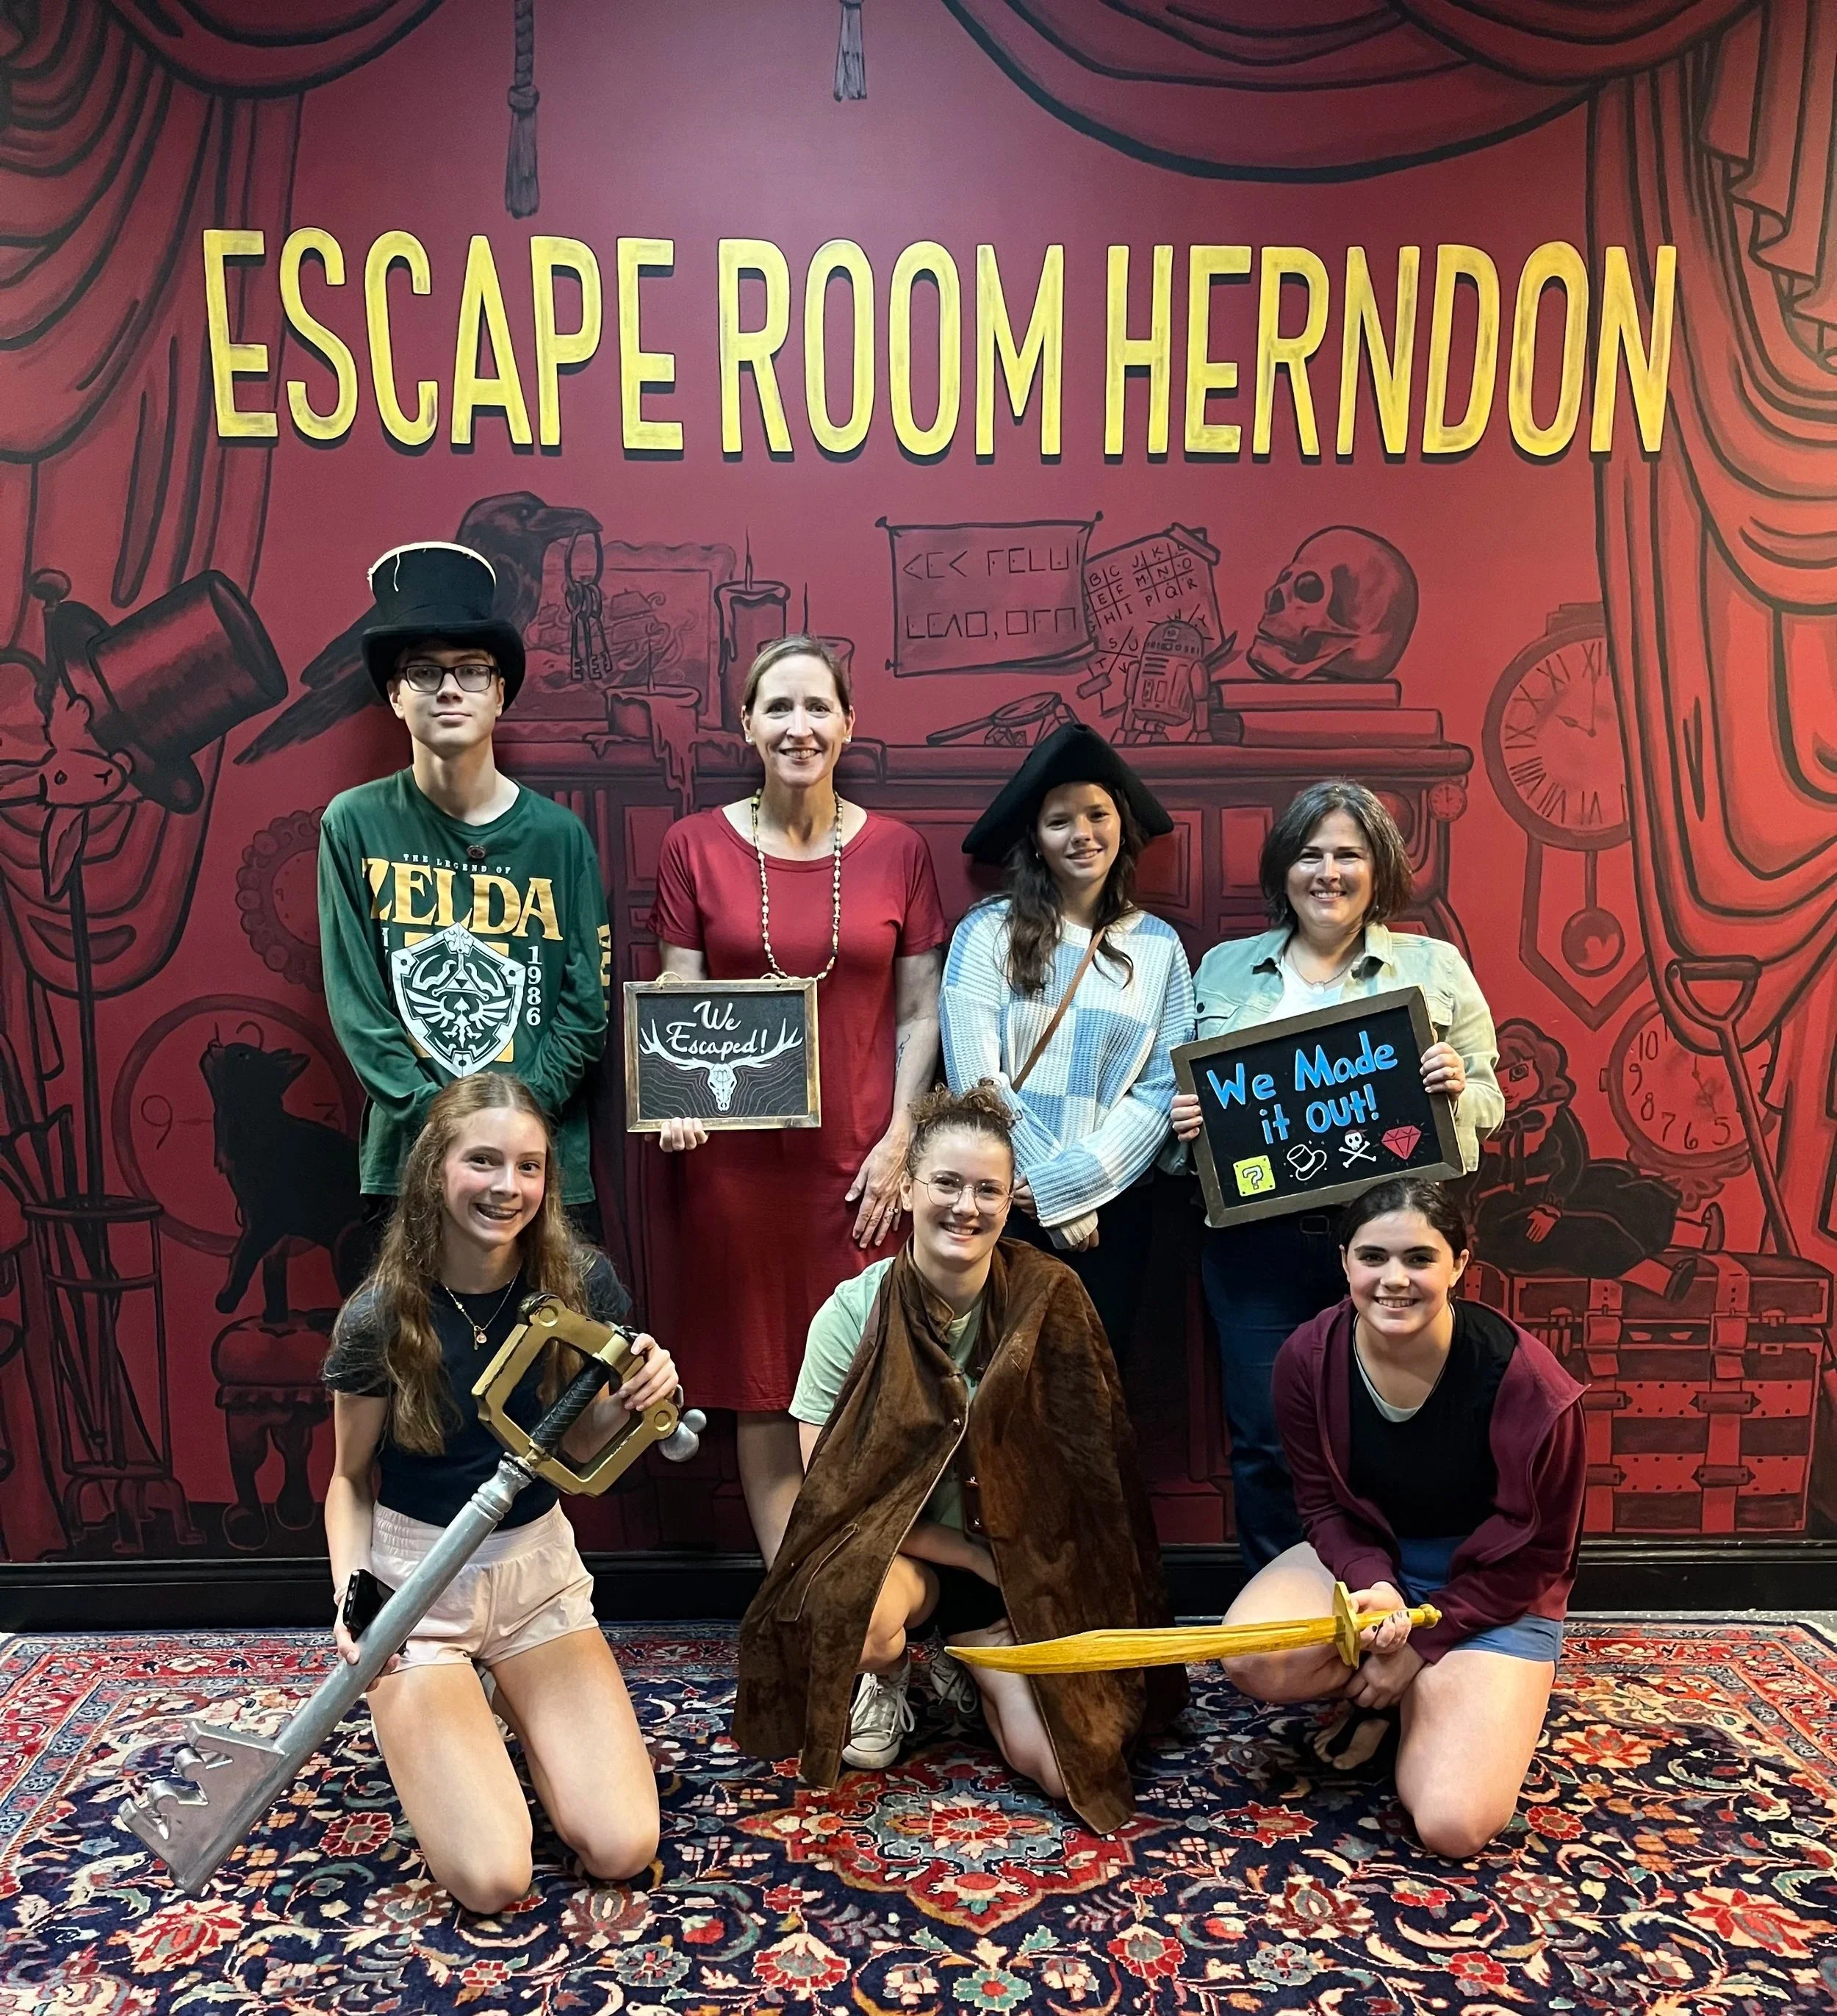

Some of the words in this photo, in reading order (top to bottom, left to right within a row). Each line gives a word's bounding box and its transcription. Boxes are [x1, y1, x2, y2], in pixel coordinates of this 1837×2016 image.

[202, 226, 683, 449] ESCAPE
[718, 239, 1065, 456] ROOM
[1104, 241, 1677, 456] HERNDON
[1089, 573, 1101, 586] B
[1110, 566, 1120, 577] C
[1187, 578, 1198, 589] R
[1098, 593, 1107, 605] E
[1116, 585, 1124, 595] F
[1145, 595, 1152, 606] P
[1104, 612, 1115, 624] H
[1110, 637, 1118, 649] S
[403, 853, 428, 863] THE
[436, 858, 487, 873] LEGEND
[495, 866, 511, 875] OF
[362, 857, 564, 941] ZELDA
[526, 945, 543, 1026] 1986
[693, 1000, 741, 1031] We
[666, 1022, 768, 1061] Escaped!
[1639, 1030, 1658, 1061] 10
[1206, 1063, 1276, 1110] We
[1295, 1030, 1398, 1091] Made
[1629, 1063, 1643, 1096] 9
[1640, 1092, 1654, 1121] 8
[141, 1095, 173, 1149] 9
[1259, 1103, 1290, 1144] it
[1661, 1111, 1676, 1142] 7
[1683, 1122, 1699, 1149] 6
[1712, 1116, 1730, 1146] 5
